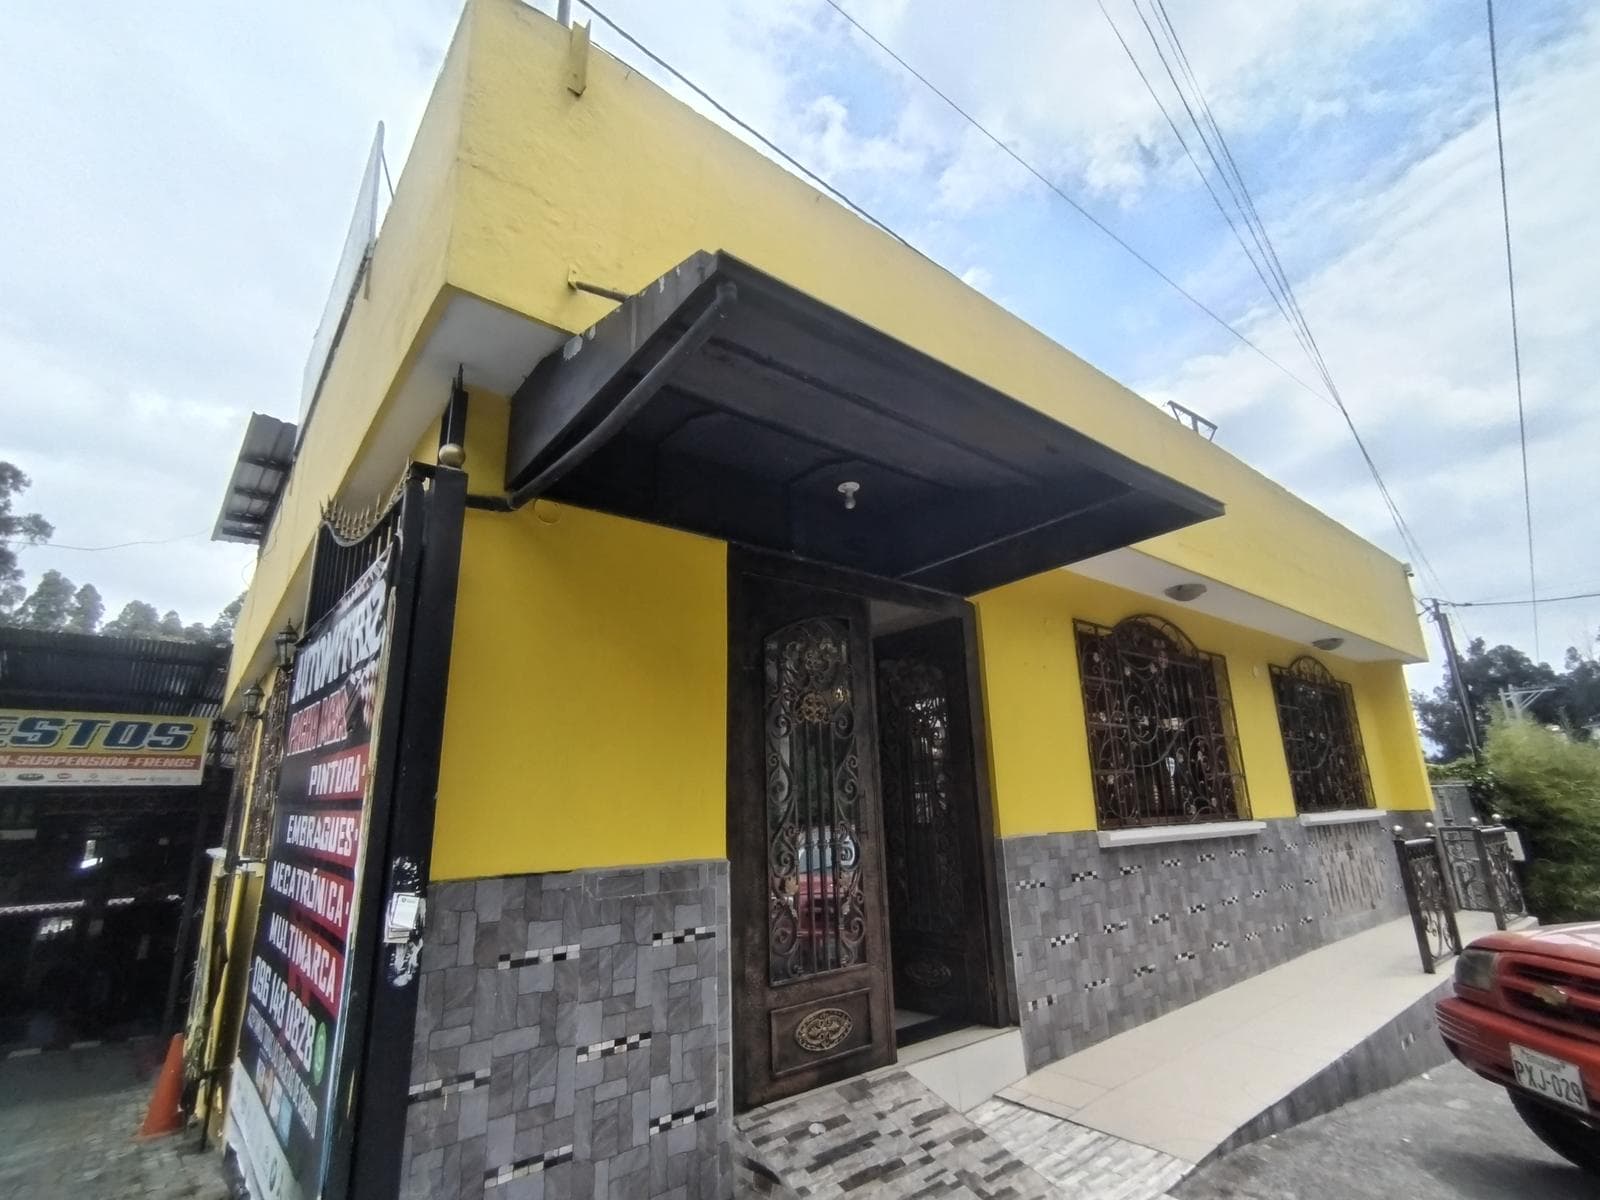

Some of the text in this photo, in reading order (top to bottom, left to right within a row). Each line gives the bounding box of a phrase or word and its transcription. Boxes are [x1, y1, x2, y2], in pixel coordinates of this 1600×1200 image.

[308, 754, 361, 796] PINTURA
[286, 814, 355, 857] EMBRAGUES
[270, 860, 345, 928] MECATRÓNICA
[269, 912, 336, 1004] MULTIMARCA
[252, 955, 272, 1007] 096
[269, 972, 288, 1029] 148
[285, 990, 316, 1072] 0828
[1513, 1060, 1583, 1106] PXJ-029
